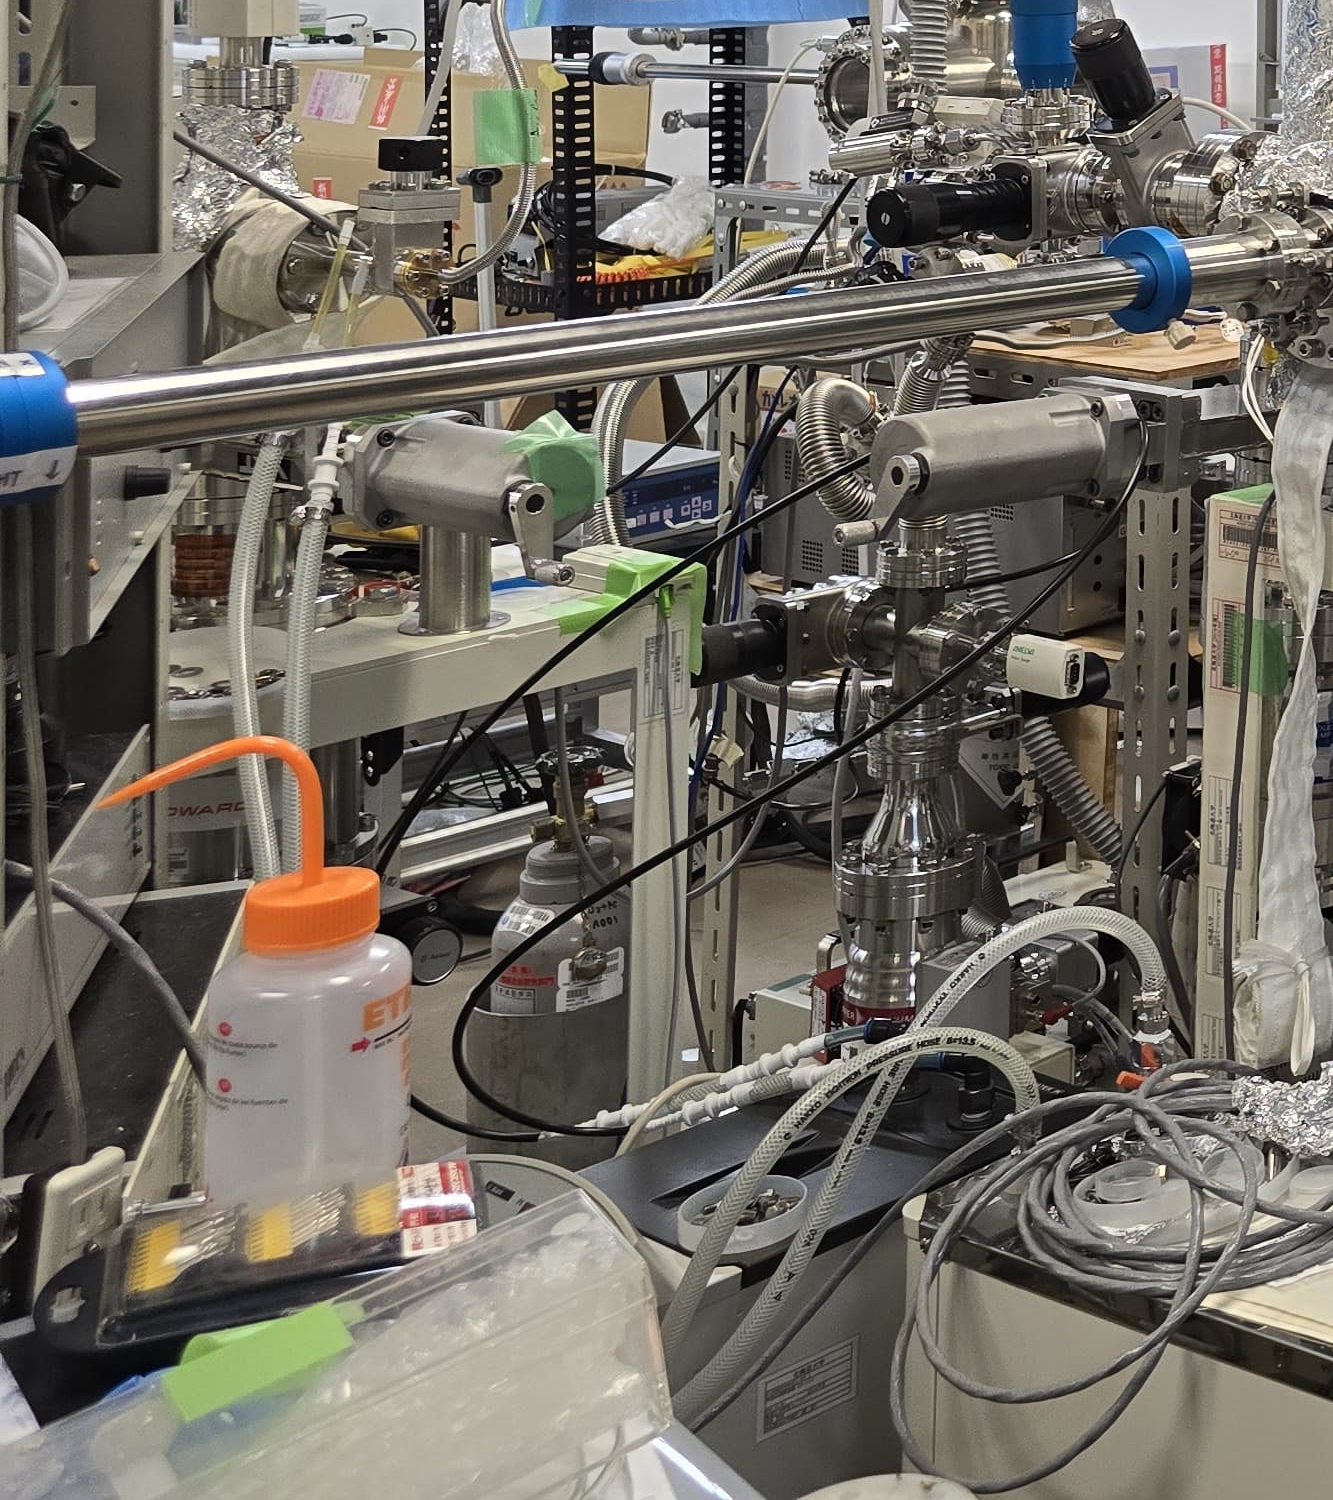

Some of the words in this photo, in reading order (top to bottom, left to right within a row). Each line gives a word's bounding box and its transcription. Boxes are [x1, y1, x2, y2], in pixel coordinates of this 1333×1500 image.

[794, 1101, 822, 1129] HAKKO
[866, 1043, 913, 1072] PRESSURE
[917, 1037, 941, 1049] HOSE
[874, 1081, 892, 1108] HOSE
